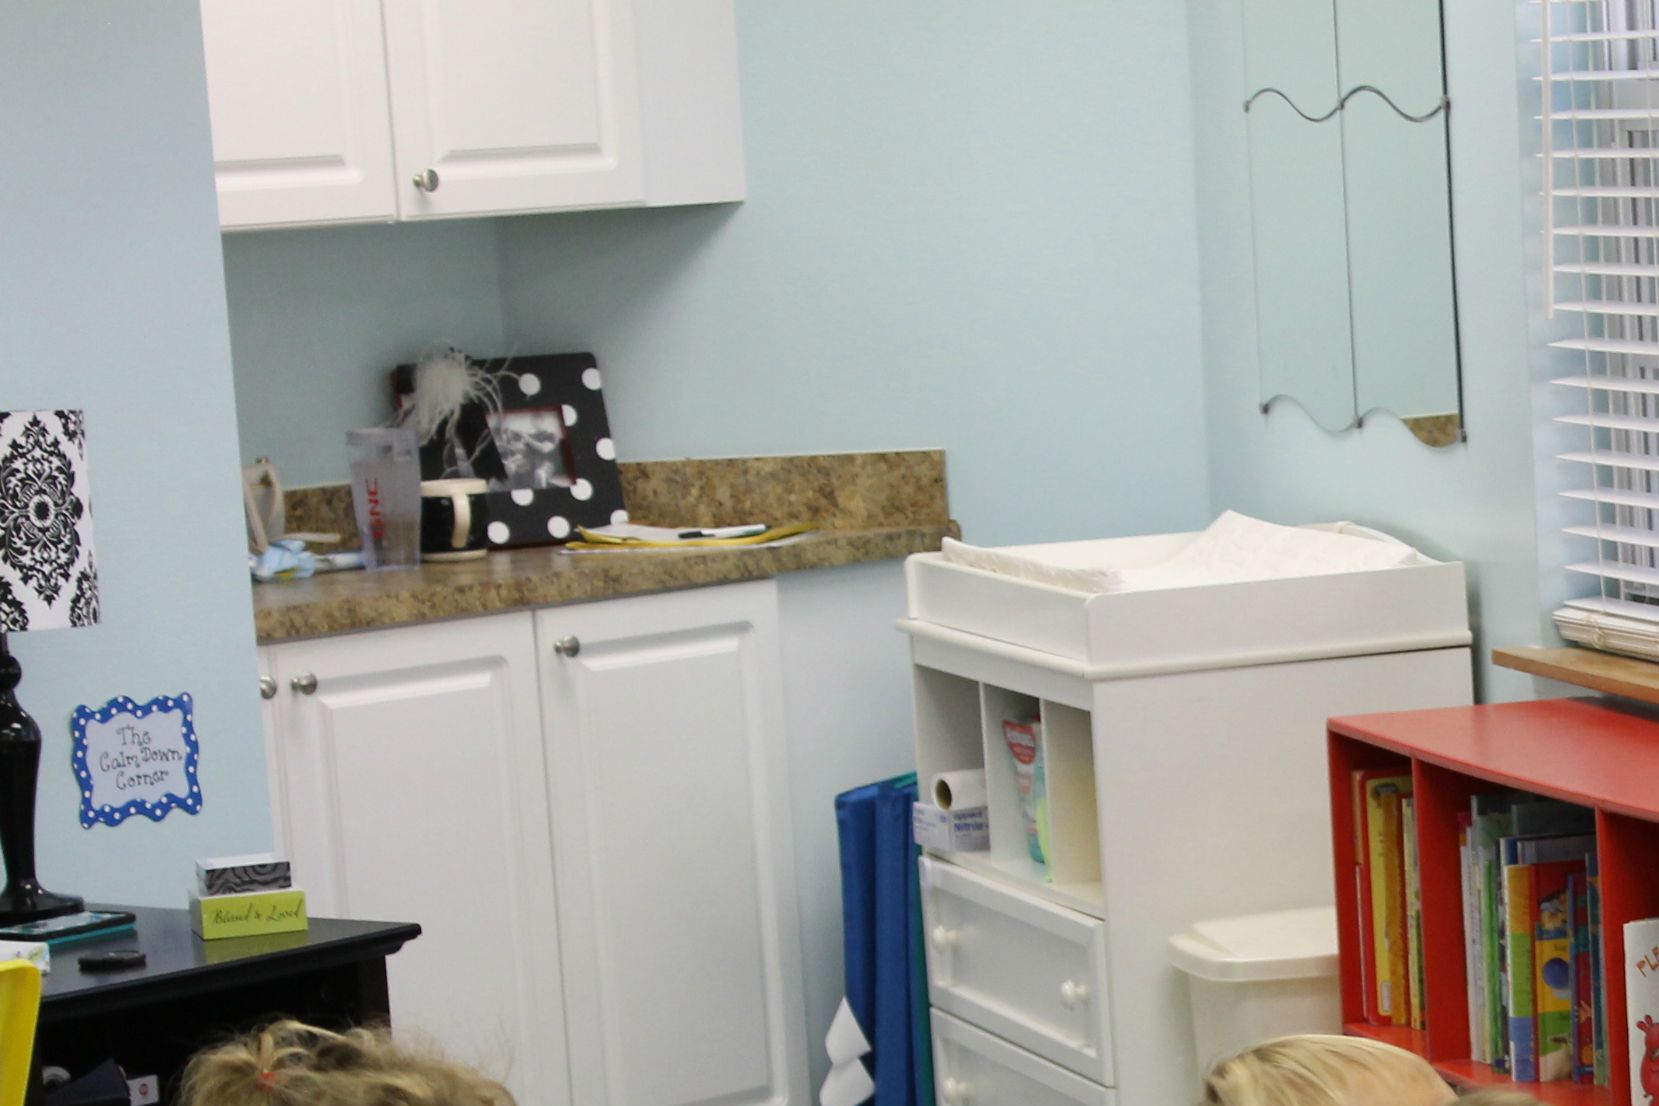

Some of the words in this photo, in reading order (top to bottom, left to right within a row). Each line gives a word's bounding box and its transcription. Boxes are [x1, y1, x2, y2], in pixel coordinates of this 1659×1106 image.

[365, 479, 385, 539] GNC
[115, 725, 152, 746] The
[99, 750, 141, 773] Calm
[140, 746, 183, 763] Down
[115, 770, 169, 791] Corner
